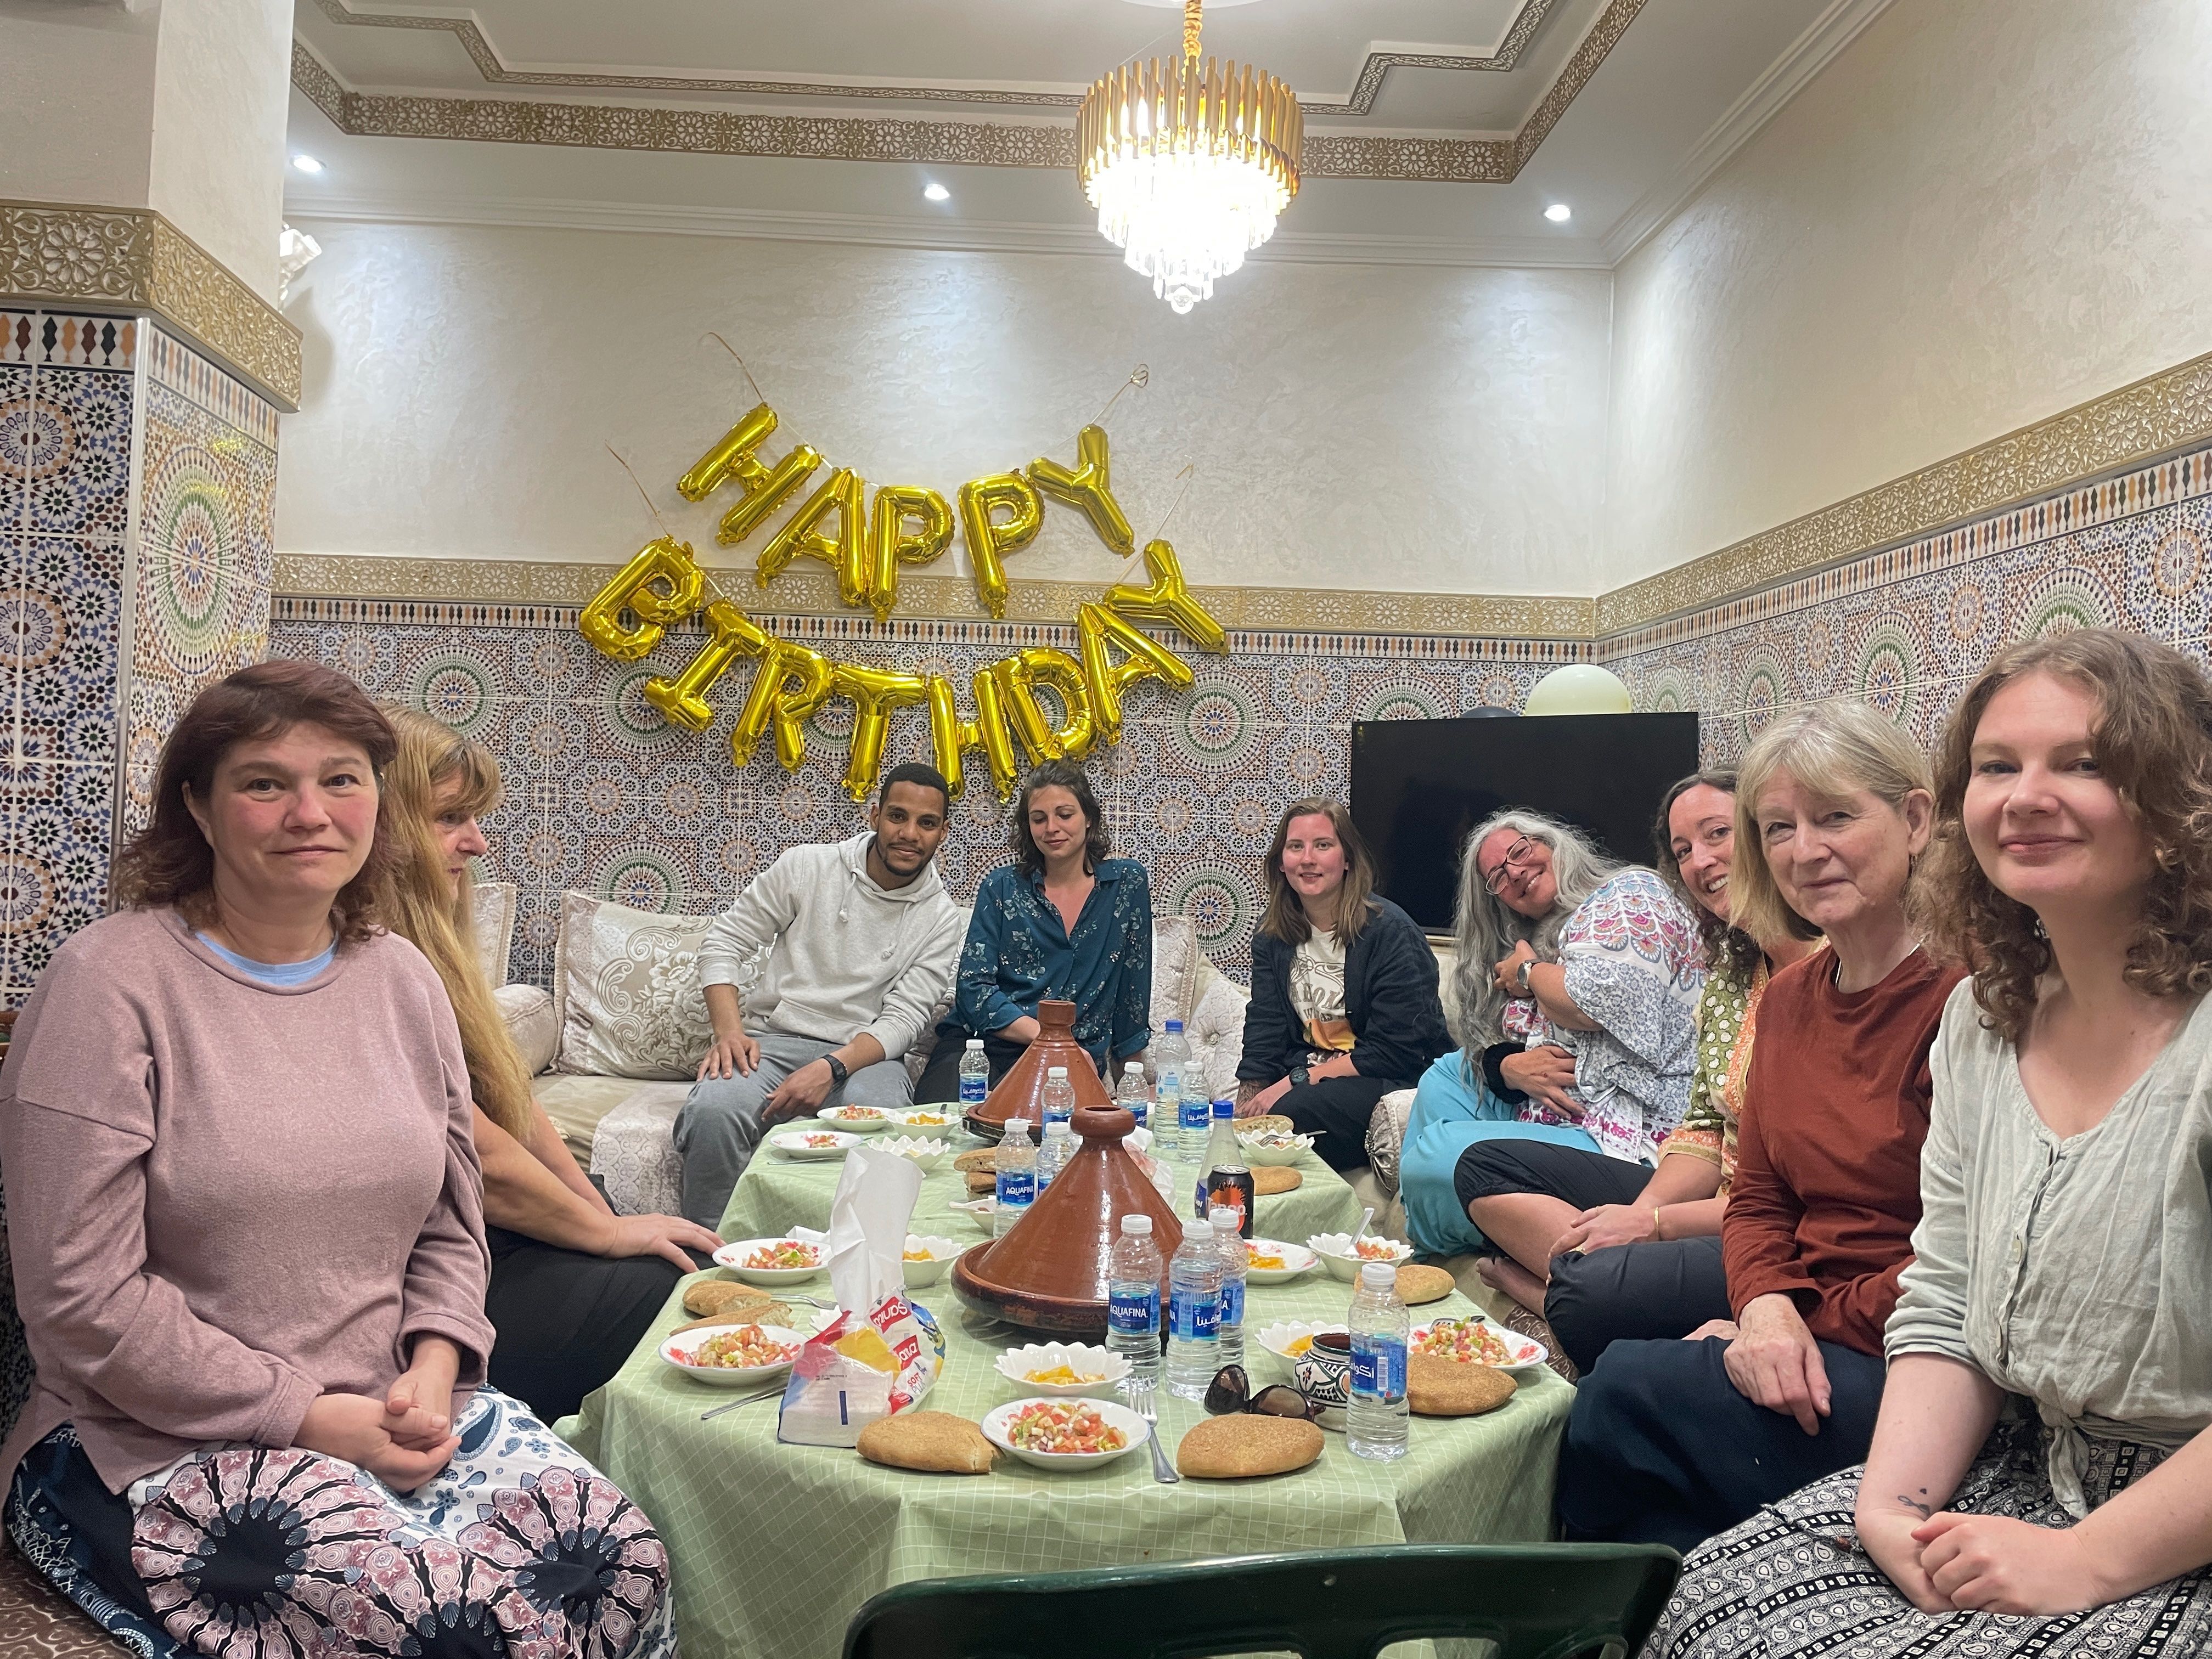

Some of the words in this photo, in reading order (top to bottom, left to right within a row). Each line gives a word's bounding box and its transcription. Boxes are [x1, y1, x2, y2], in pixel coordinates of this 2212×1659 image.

[677, 402, 1135, 622] HAPPY
[579, 535, 1230, 804] BIRTHDAY
[907, 1372, 923, 1387] SOFT
